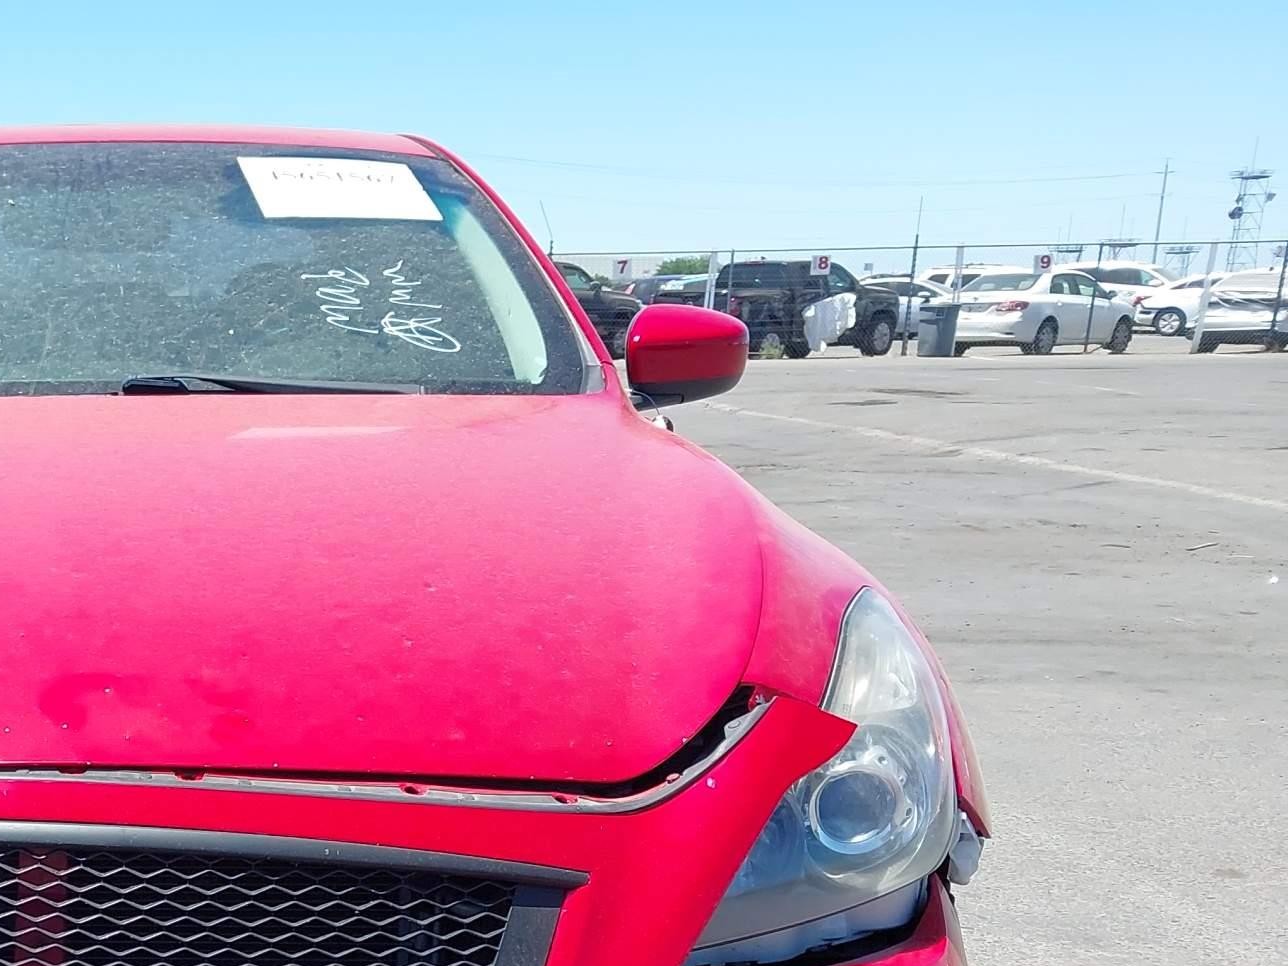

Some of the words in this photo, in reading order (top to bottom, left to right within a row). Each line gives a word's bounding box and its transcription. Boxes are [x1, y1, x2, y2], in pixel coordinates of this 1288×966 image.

[617, 260, 628, 274] 7
[818, 256, 829, 270] 8
[1040, 255, 1051, 269] 9
